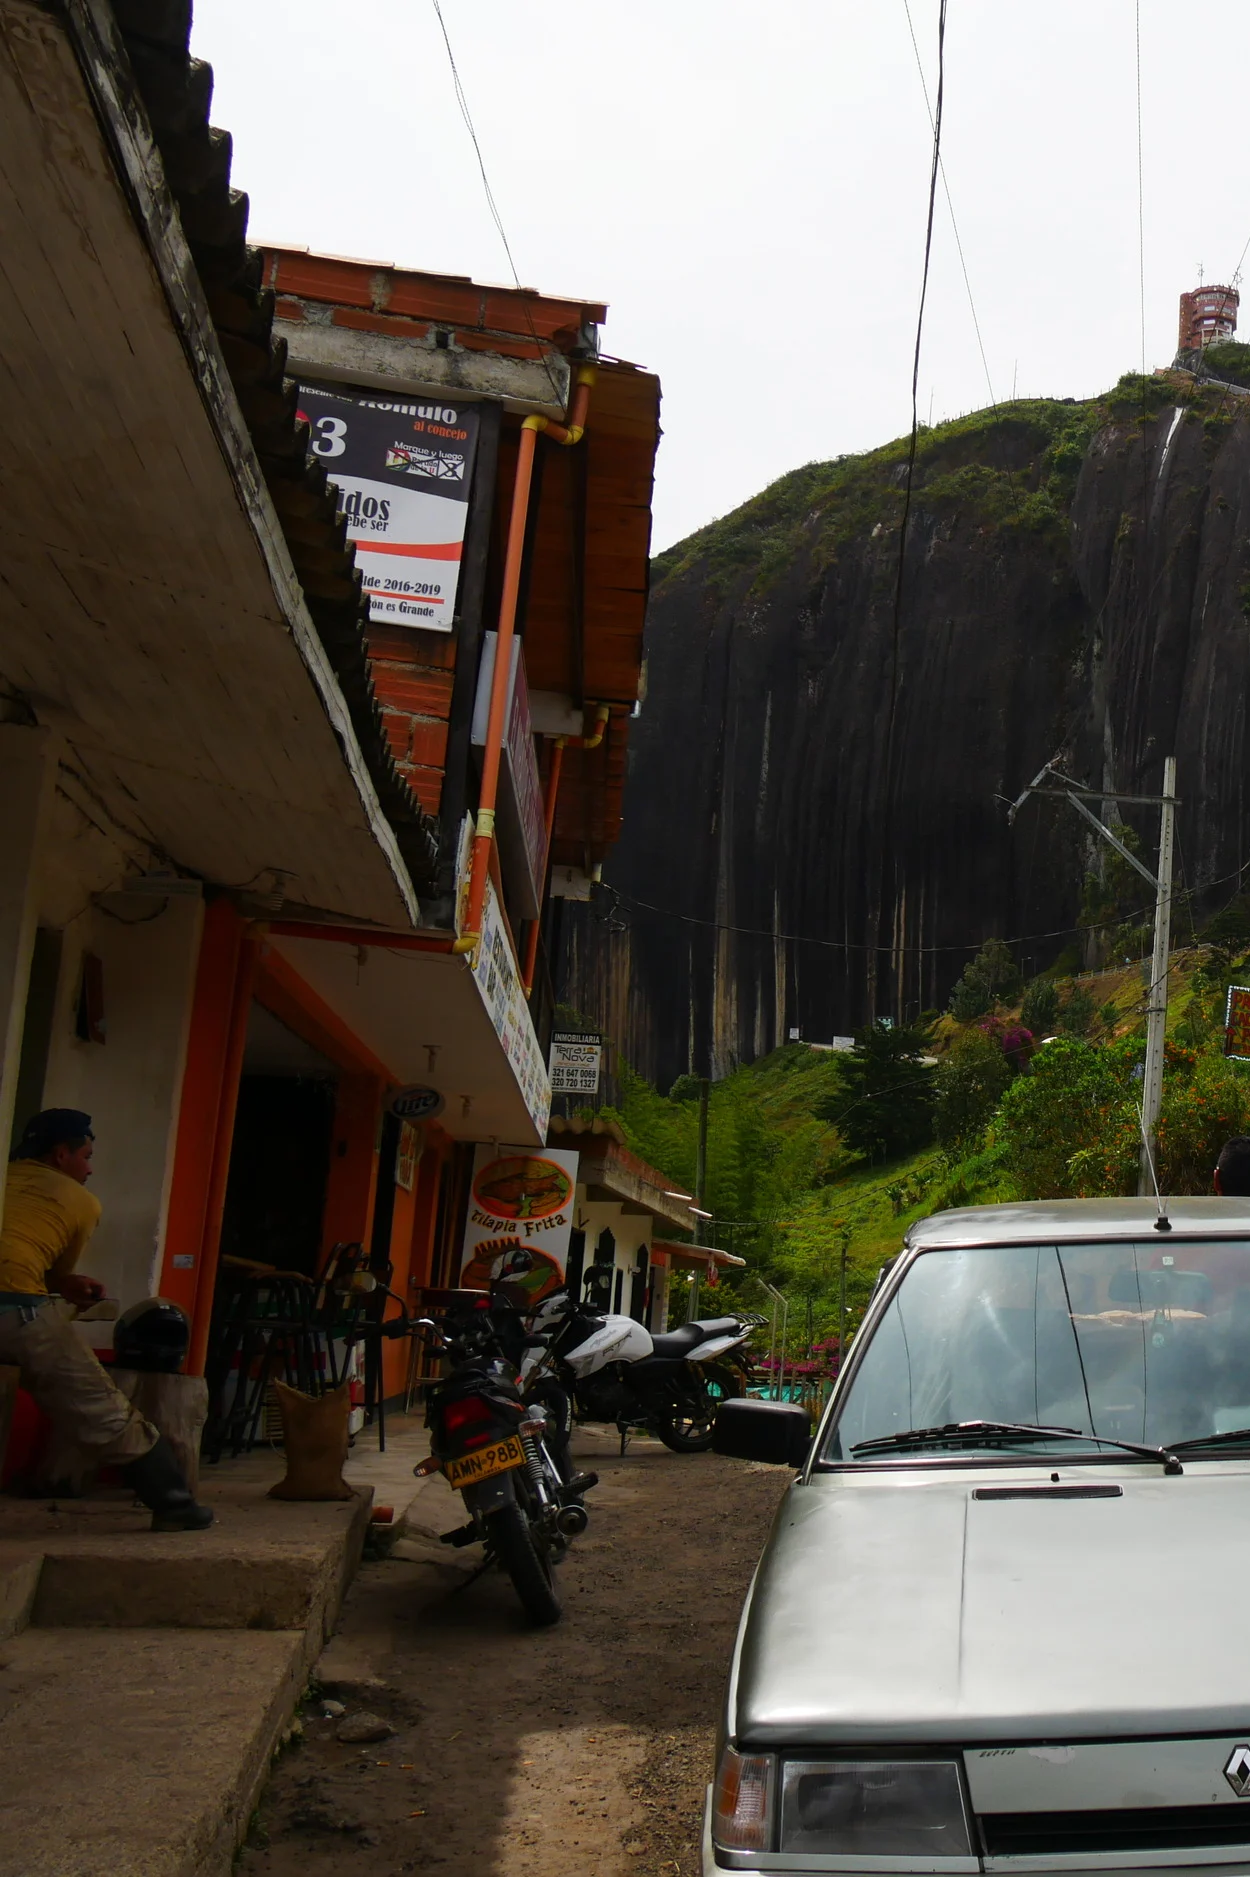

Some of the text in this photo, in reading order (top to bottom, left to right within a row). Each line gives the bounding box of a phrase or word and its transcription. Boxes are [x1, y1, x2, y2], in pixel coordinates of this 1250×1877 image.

[413, 420, 467, 441] al concejo
[394, 441, 464, 461] Marque y luego
[370, 519, 389, 532] ser
[384, 578, 441, 596] 2016-2019
[386, 602, 396, 612] es
[399, 600, 435, 617] Grande
[554, 1033, 600, 1044] INMOBILIARIA
[554, 1045, 582, 1058] Terra
[562, 1053, 595, 1063] Nova
[552, 1068, 564, 1077] 321
[566, 1068, 578, 1078] 647
[552, 1078, 596, 1088] 320 720 1327
[471, 1209, 568, 1238] Tilapia Frita
